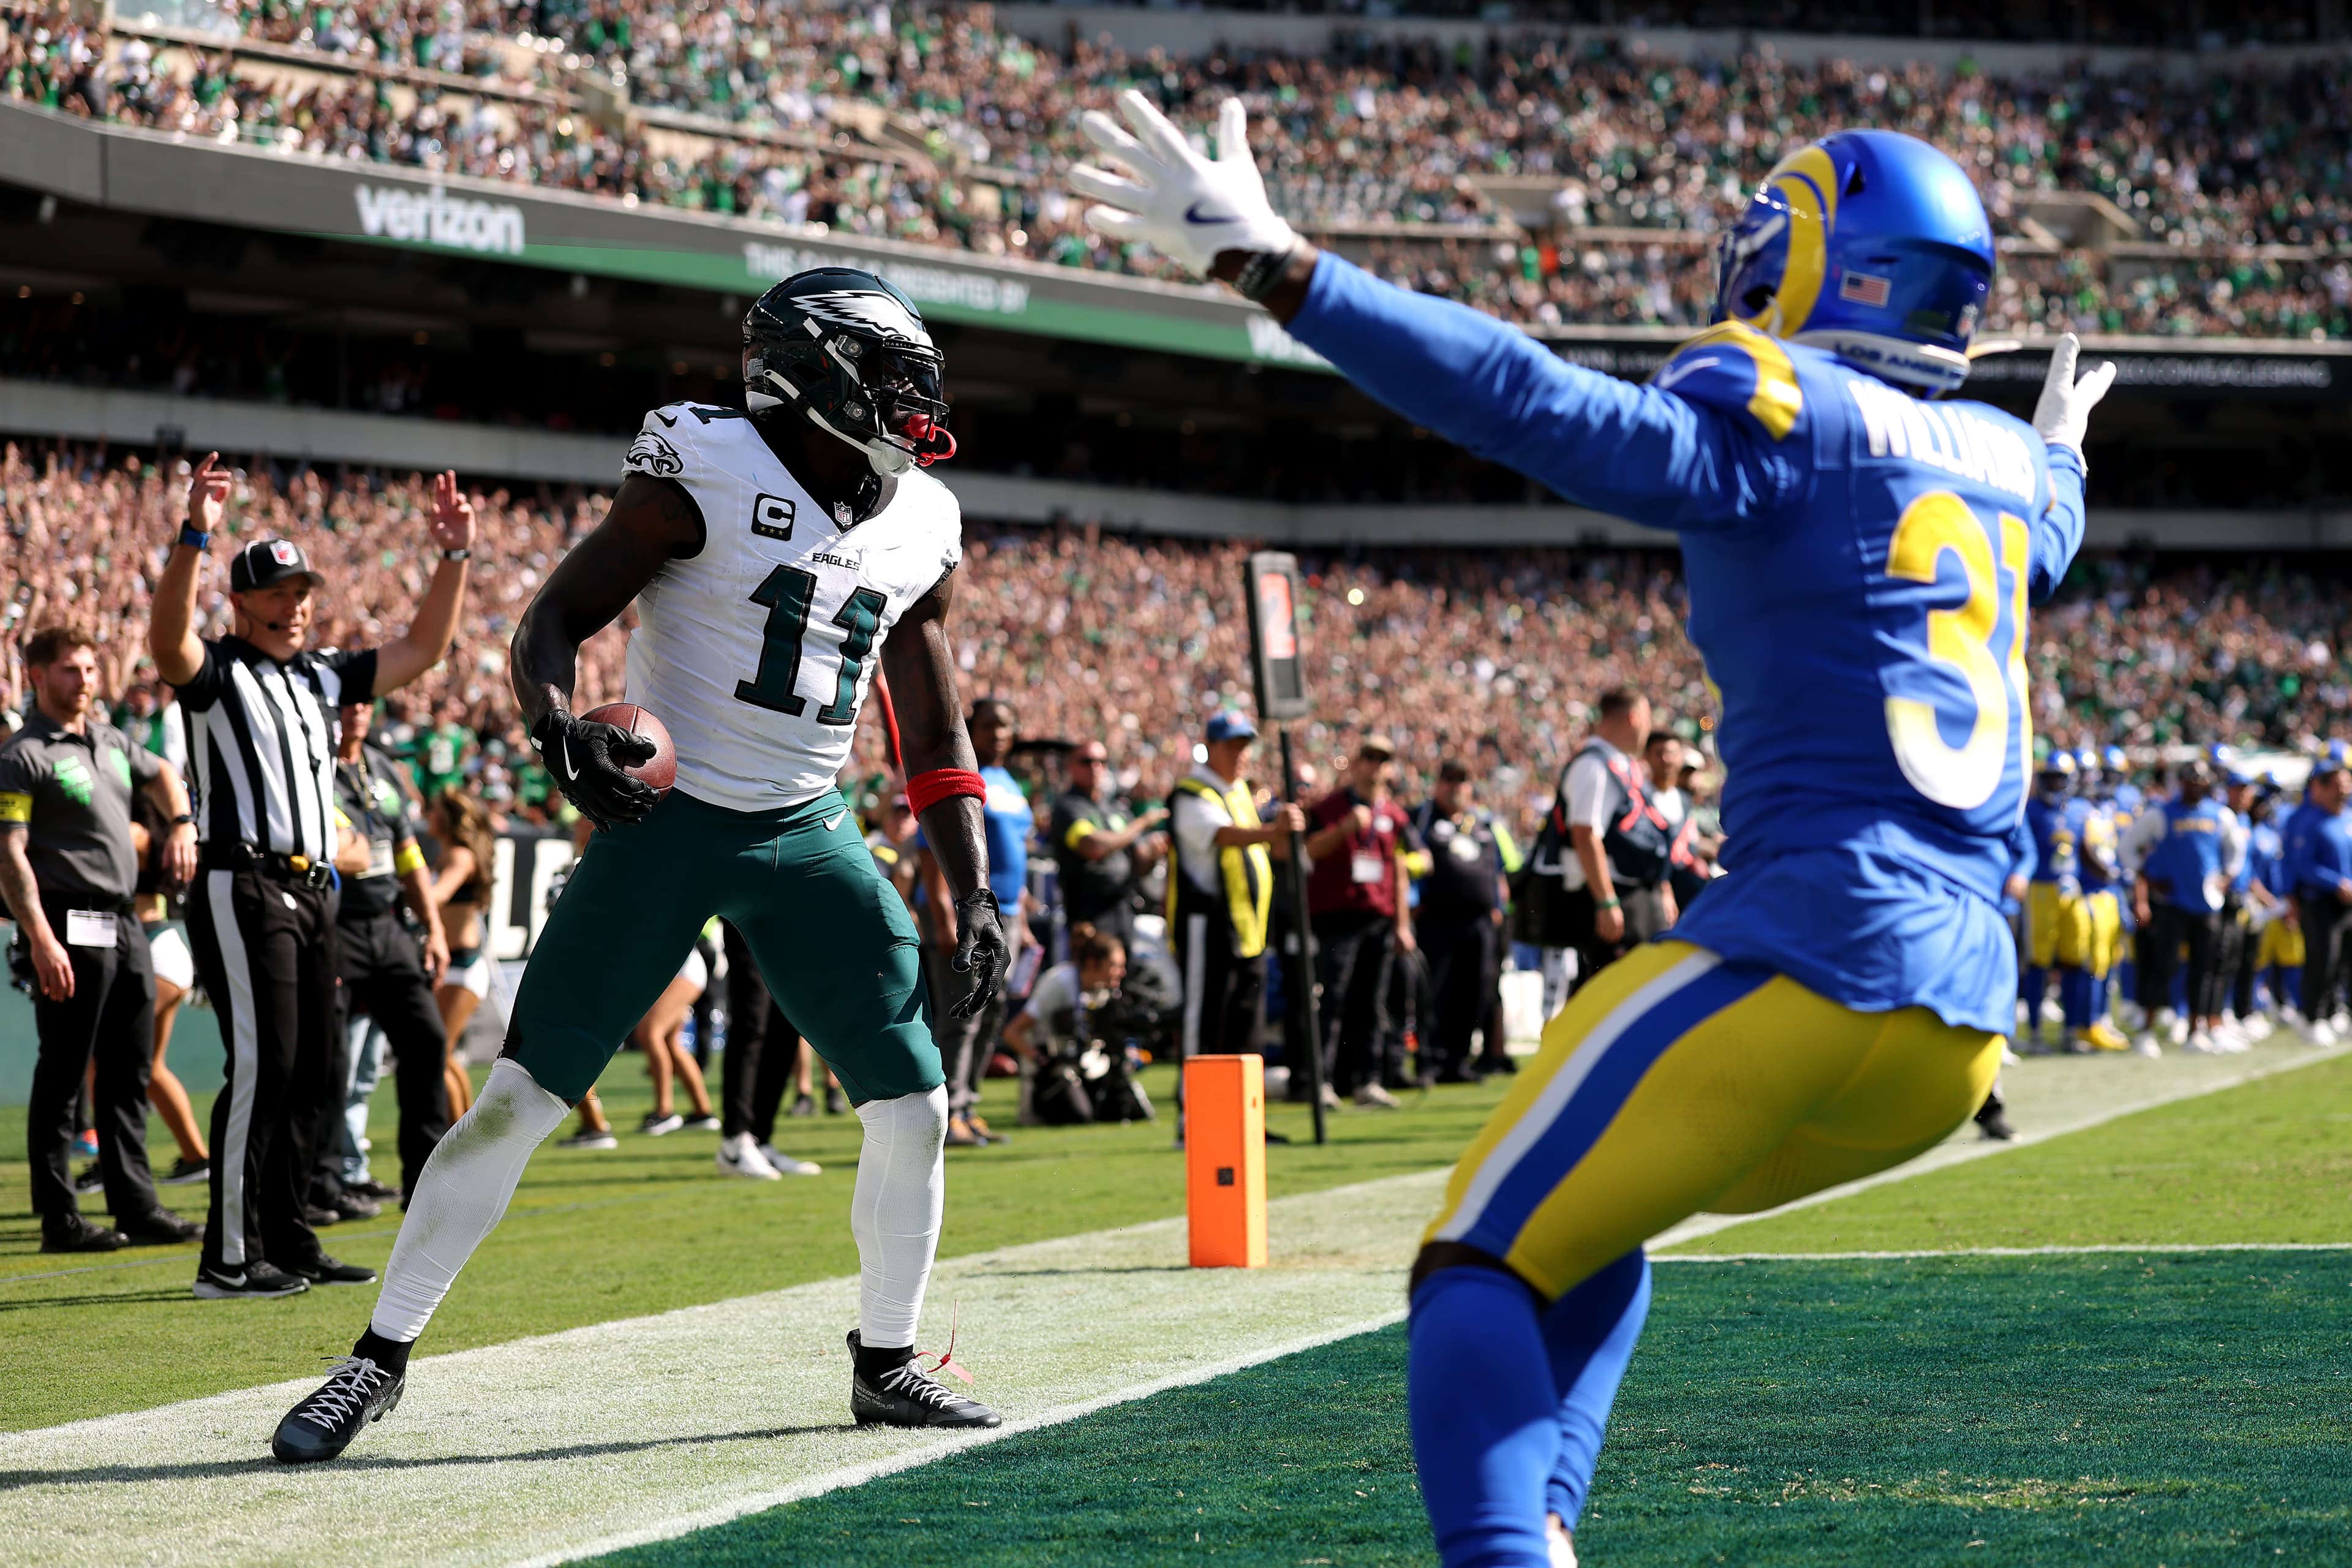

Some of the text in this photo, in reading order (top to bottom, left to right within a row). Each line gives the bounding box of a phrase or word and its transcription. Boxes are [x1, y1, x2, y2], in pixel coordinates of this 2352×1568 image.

[355, 184, 525, 255] verizon
[758, 497, 792, 529] C
[837, 510, 850, 522] NFL
[812, 552, 861, 571] EAGLES
[733, 564, 887, 725] 11
[1885, 491, 2033, 826] 31
